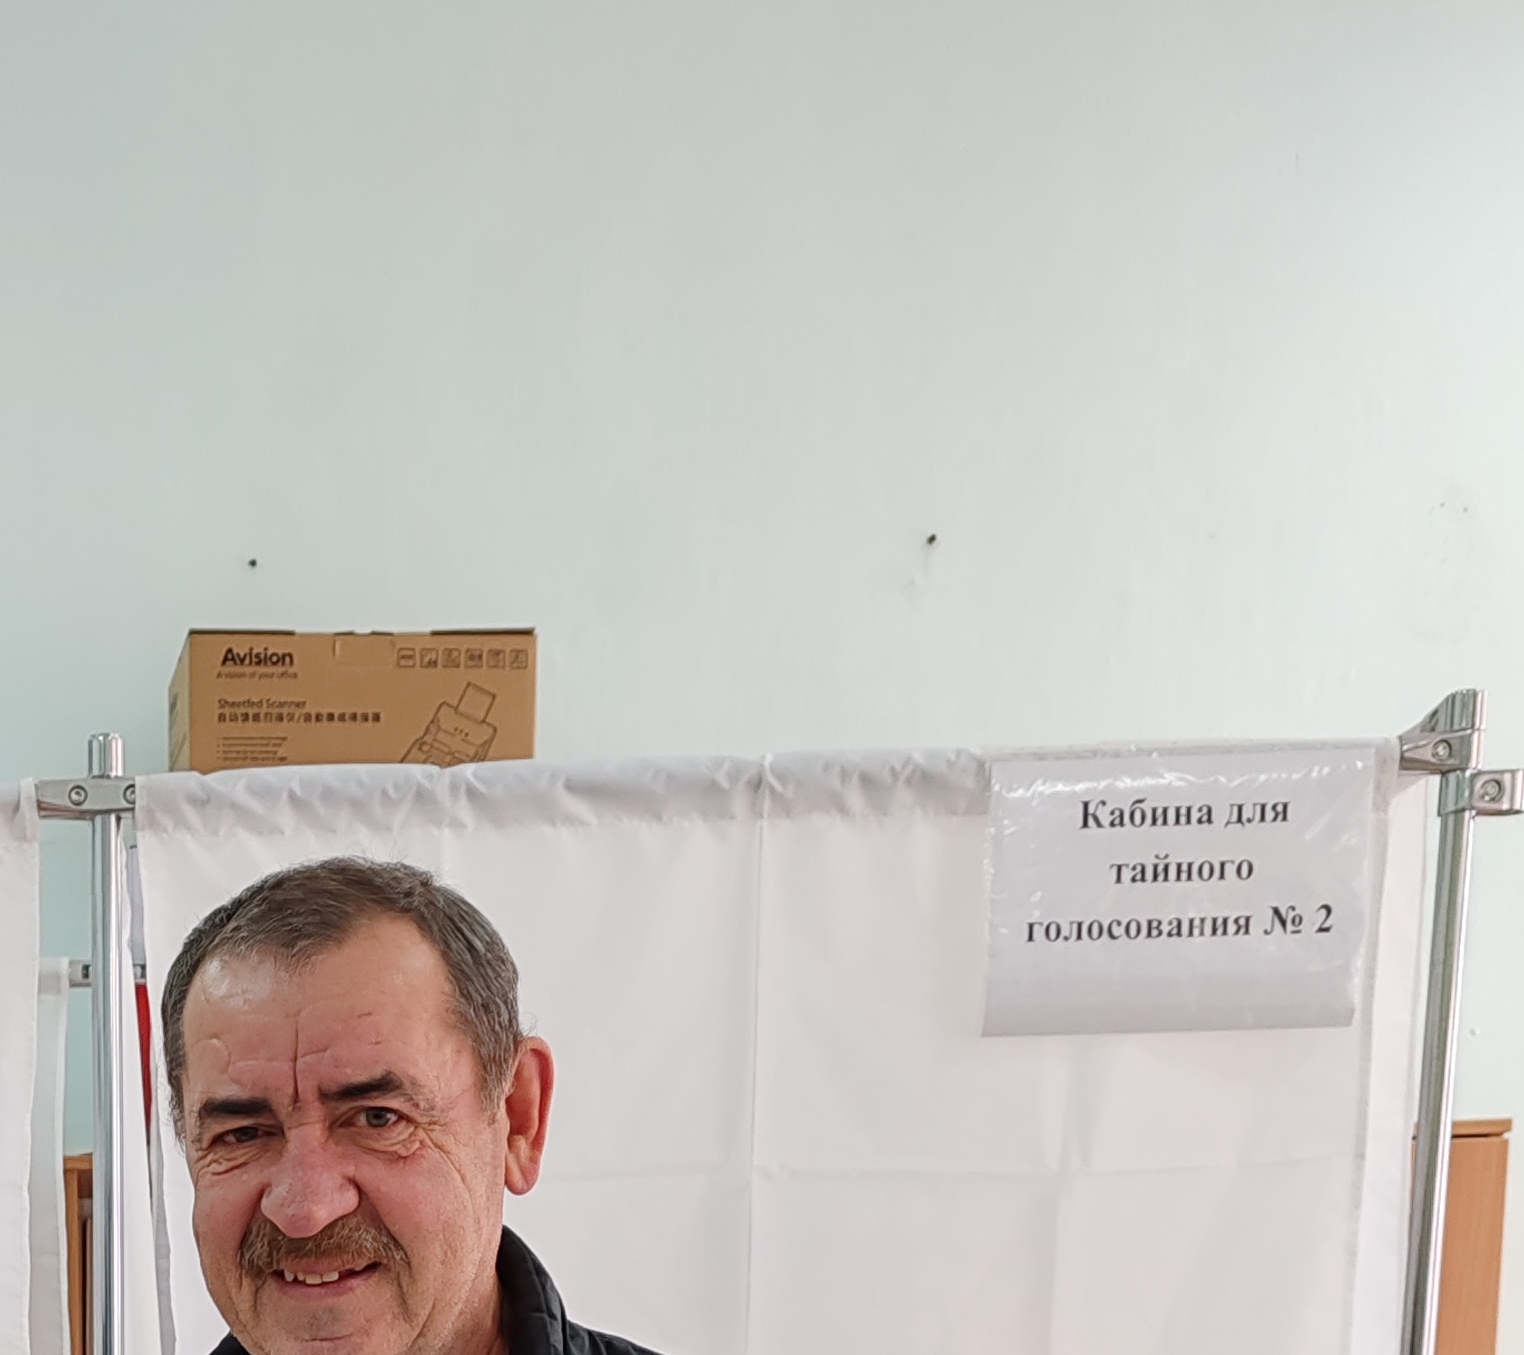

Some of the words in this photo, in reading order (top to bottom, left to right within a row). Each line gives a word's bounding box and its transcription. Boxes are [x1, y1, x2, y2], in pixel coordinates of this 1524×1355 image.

[221, 646, 294, 666] Avision
[217, 698, 263, 709] Sheetfed
[266, 699, 307, 709] Scanner
[1079, 798, 1213, 830] Кабина
[1224, 799, 1291, 828] для
[1109, 853, 1254, 885] тайного
[1025, 913, 1252, 943] голосования
[1263, 905, 1305, 936] №
[1314, 903, 1334, 934] 2
